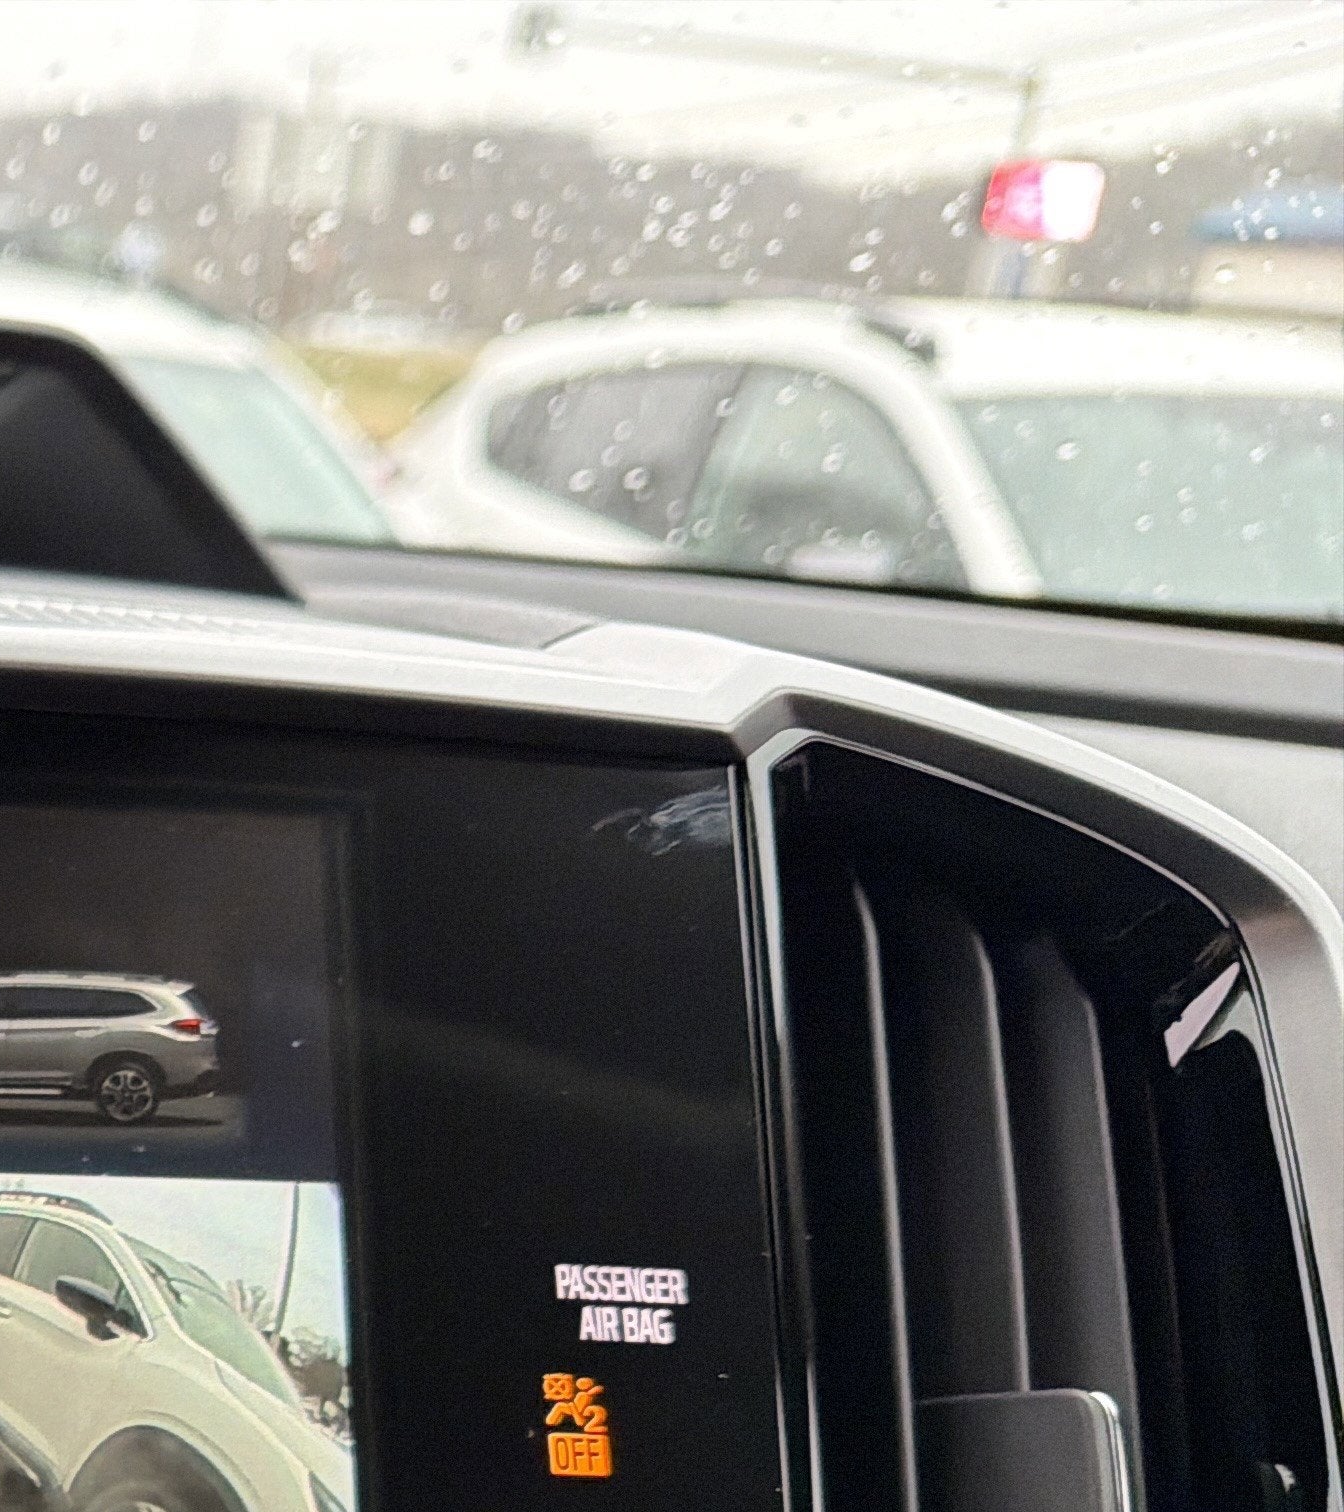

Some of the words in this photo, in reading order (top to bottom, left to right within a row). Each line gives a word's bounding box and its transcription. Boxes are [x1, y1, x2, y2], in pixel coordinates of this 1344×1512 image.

[554, 1263, 688, 1304] PASSENGER
[579, 1305, 621, 1342] AIR
[622, 1306, 676, 1344] BAG
[554, 1436, 602, 1473] OFF
